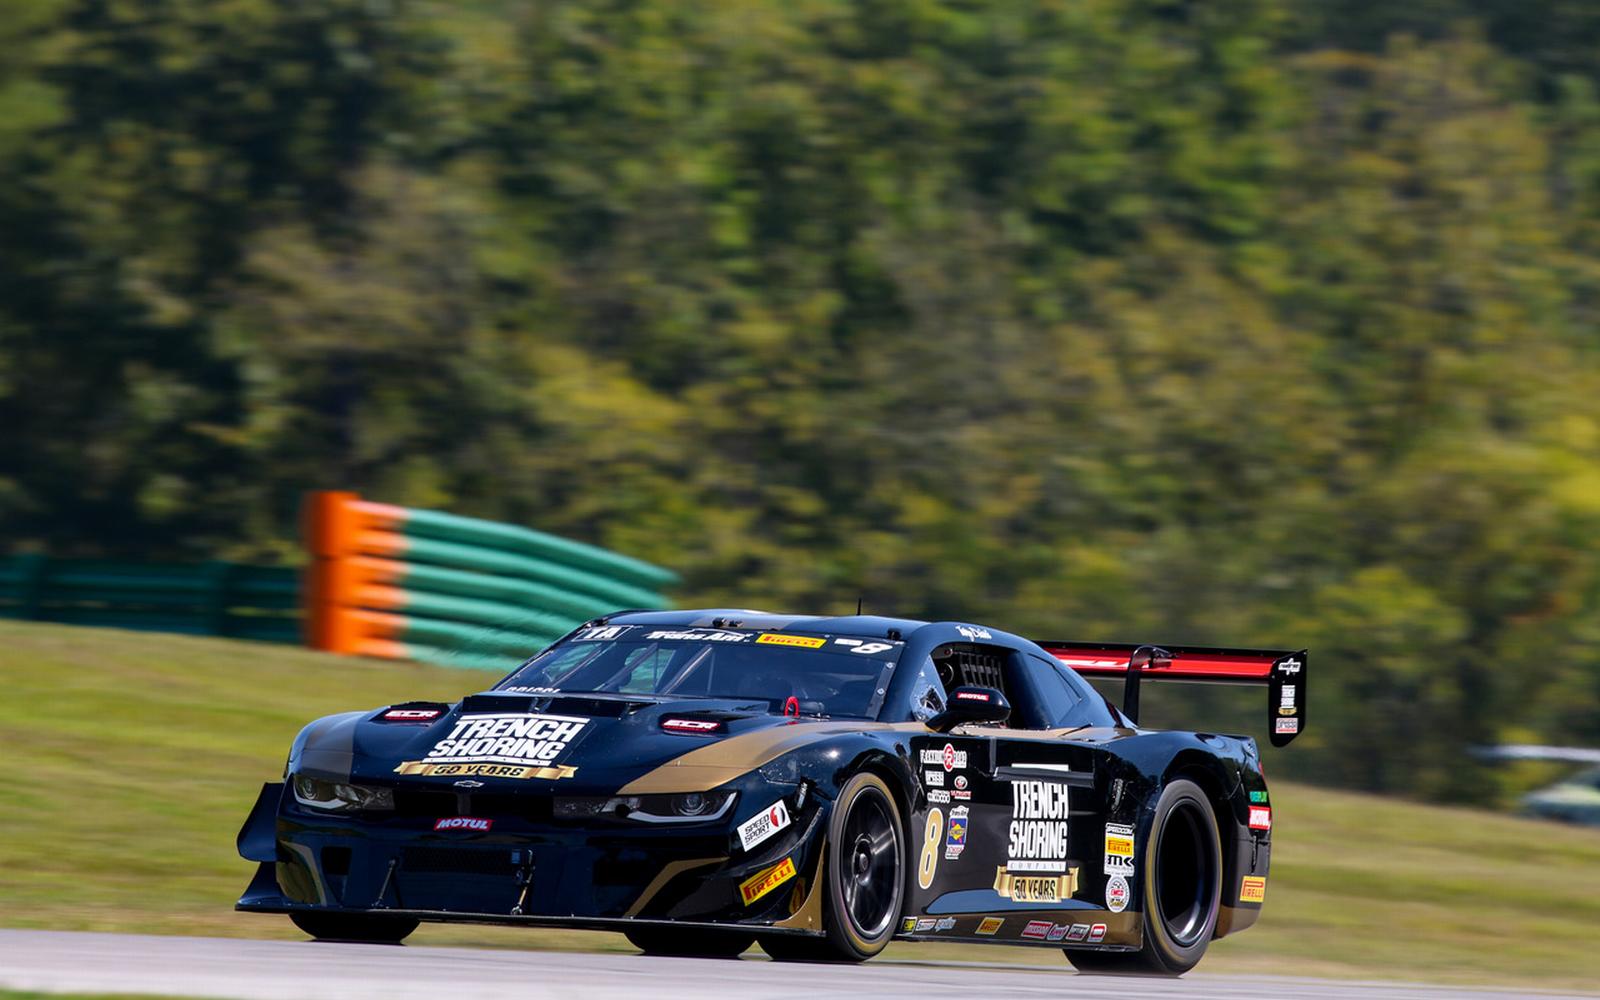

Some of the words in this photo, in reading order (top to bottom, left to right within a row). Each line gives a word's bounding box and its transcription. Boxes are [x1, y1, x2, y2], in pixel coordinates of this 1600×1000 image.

[583, 627, 619, 639] TA
[763, 635, 820, 646] PIRELLI
[850, 642, 893, 654] 8
[958, 693, 989, 701] MOTUL
[446, 717, 586, 743] TRENCH
[428, 736, 566, 760] SHORING
[434, 765, 463, 775] 50
[465, 765, 525, 777] YEARS
[1011, 780, 1069, 819] TRENCH
[435, 818, 490, 831] MOTUL
[744, 814, 771, 835] SPEED
[744, 822, 771, 843] SPORT
[918, 807, 944, 890] 8
[1008, 821, 1067, 859] SHORING
[1108, 839, 1131, 853] PIRELLI
[743, 858, 793, 900] PIRELLI
[1014, 879, 1027, 899] 50
[1028, 879, 1056, 900] YEARS
[1241, 880, 1264, 897] PIRELLI
